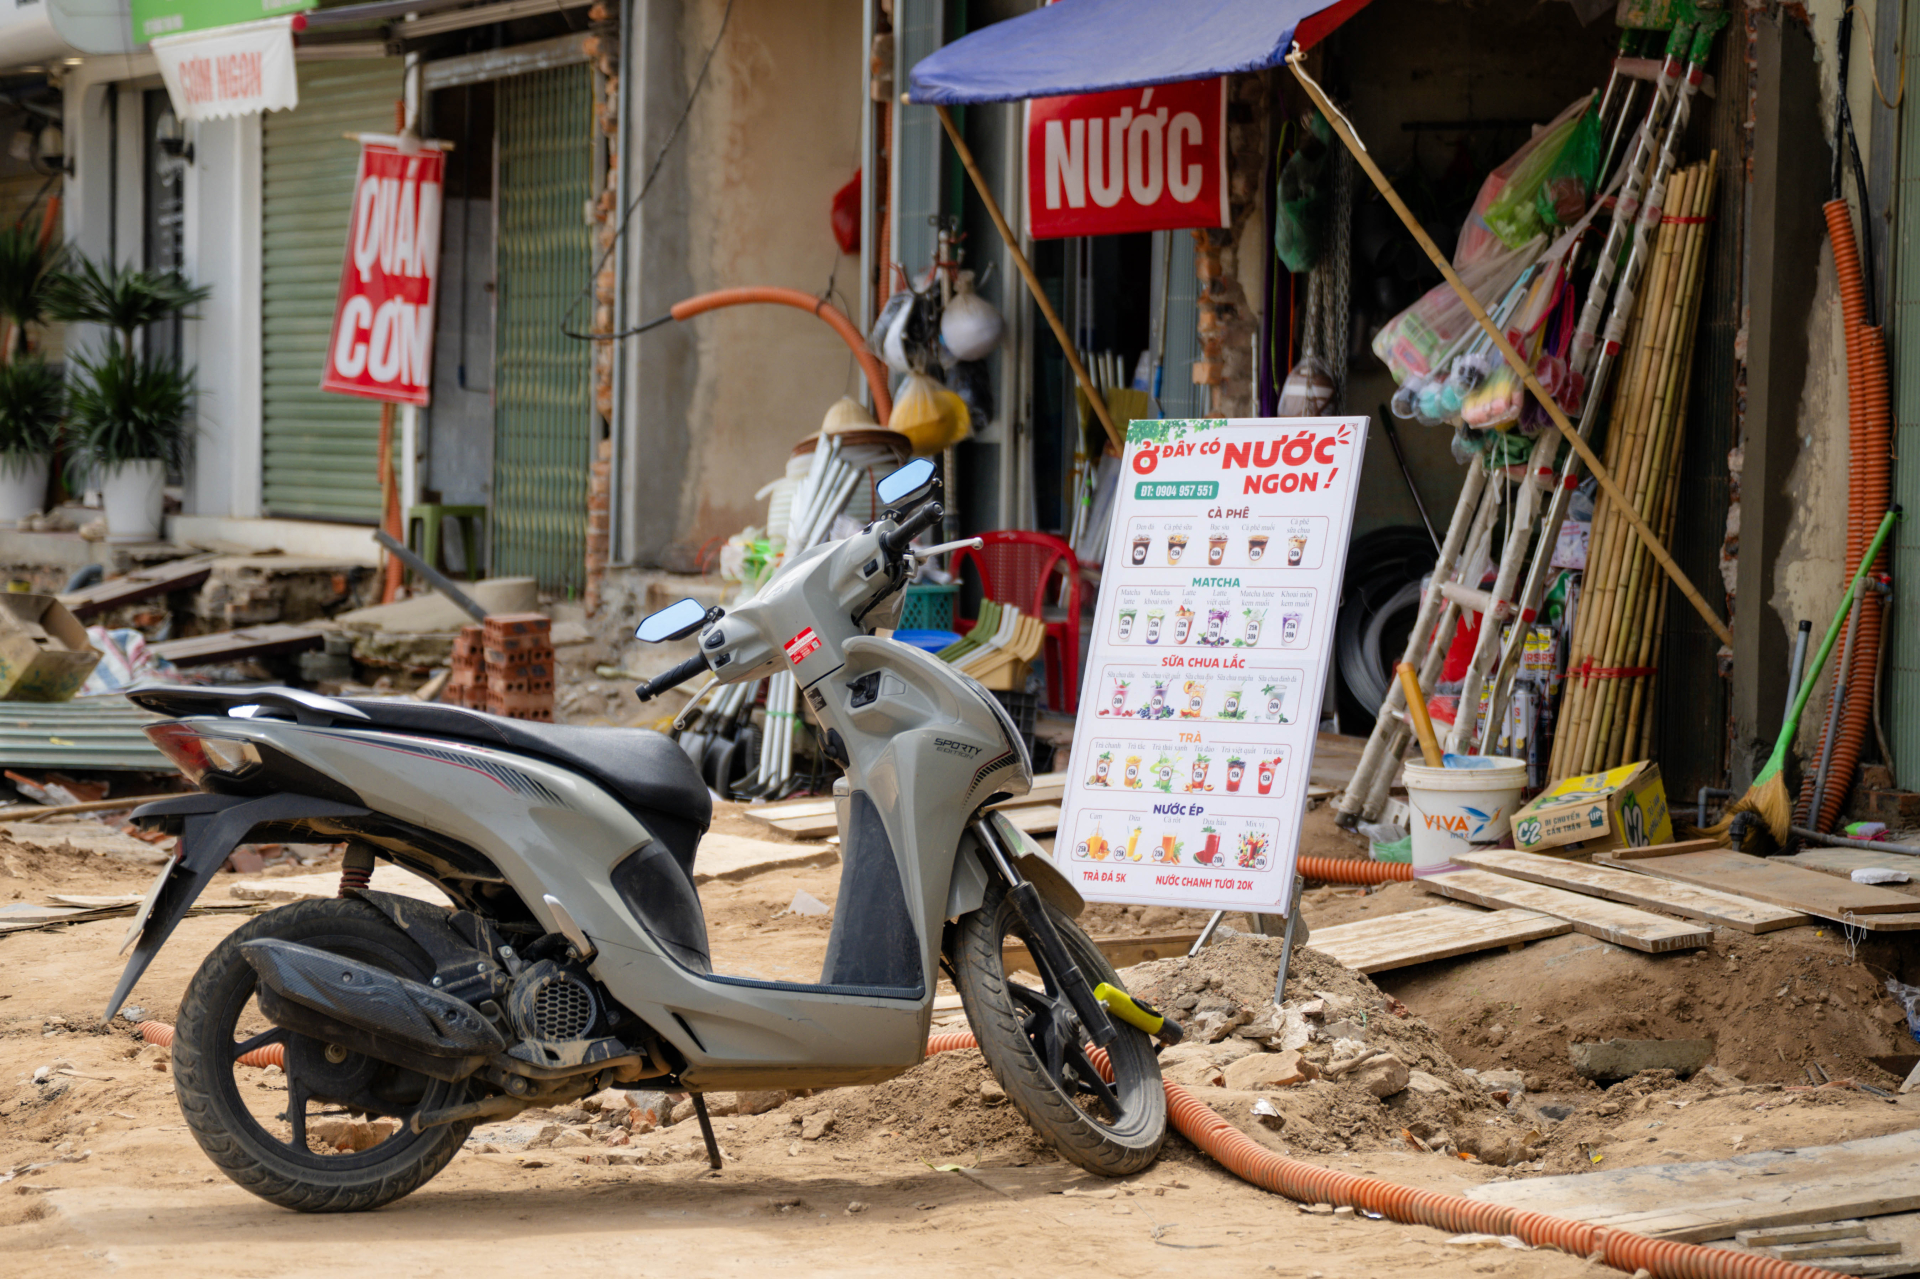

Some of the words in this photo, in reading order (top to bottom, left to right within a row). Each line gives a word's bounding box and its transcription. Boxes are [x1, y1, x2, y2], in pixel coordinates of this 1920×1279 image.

[216, 51, 262, 101] NGON
[1045, 87, 1203, 210] NƯỚC
[354, 158, 440, 283] QUÁN
[1132, 440, 1160, 474] Ở
[1162, 440, 1196, 458] ĐÂY
[1200, 437, 1221, 455] CÓ
[1222, 430, 1336, 470] NƯỚC
[1140, 485, 1154, 497] ĐT:
[1156, 485, 1178, 497] 0904
[1179, 485, 1196, 496] 957
[1197, 485, 1213, 496] 551
[1208, 506, 1222, 518] CÀ
[1226, 506, 1250, 518] PHÊ
[1192, 578, 1240, 587] MATCHA
[1162, 654, 1184, 667] SỮA
[1188, 658, 1219, 668] CHUA
[1223, 653, 1246, 669] LẮC
[1179, 731, 1202, 743] TRÀ
[934, 738, 982, 755] SPORTY
[936, 747, 974, 759] EDITION
[1153, 802, 1186, 815] NƯỚC
[1189, 804, 1204, 816] ÉP
[1590, 811, 1601, 821] UP
[1423, 814, 1469, 832] VIVA
[1517, 822, 1542, 844] C2
[1083, 870, 1099, 881] TRÀ
[1101, 870, 1113, 882] ĐÁ
[1115, 873, 1127, 882] 5K
[1156, 874, 1180, 886] NƯỚC
[1182, 877, 1212, 888] CHANH
[1214, 878, 1235, 889] TƯƠI
[1237, 880, 1254, 890] 20K
